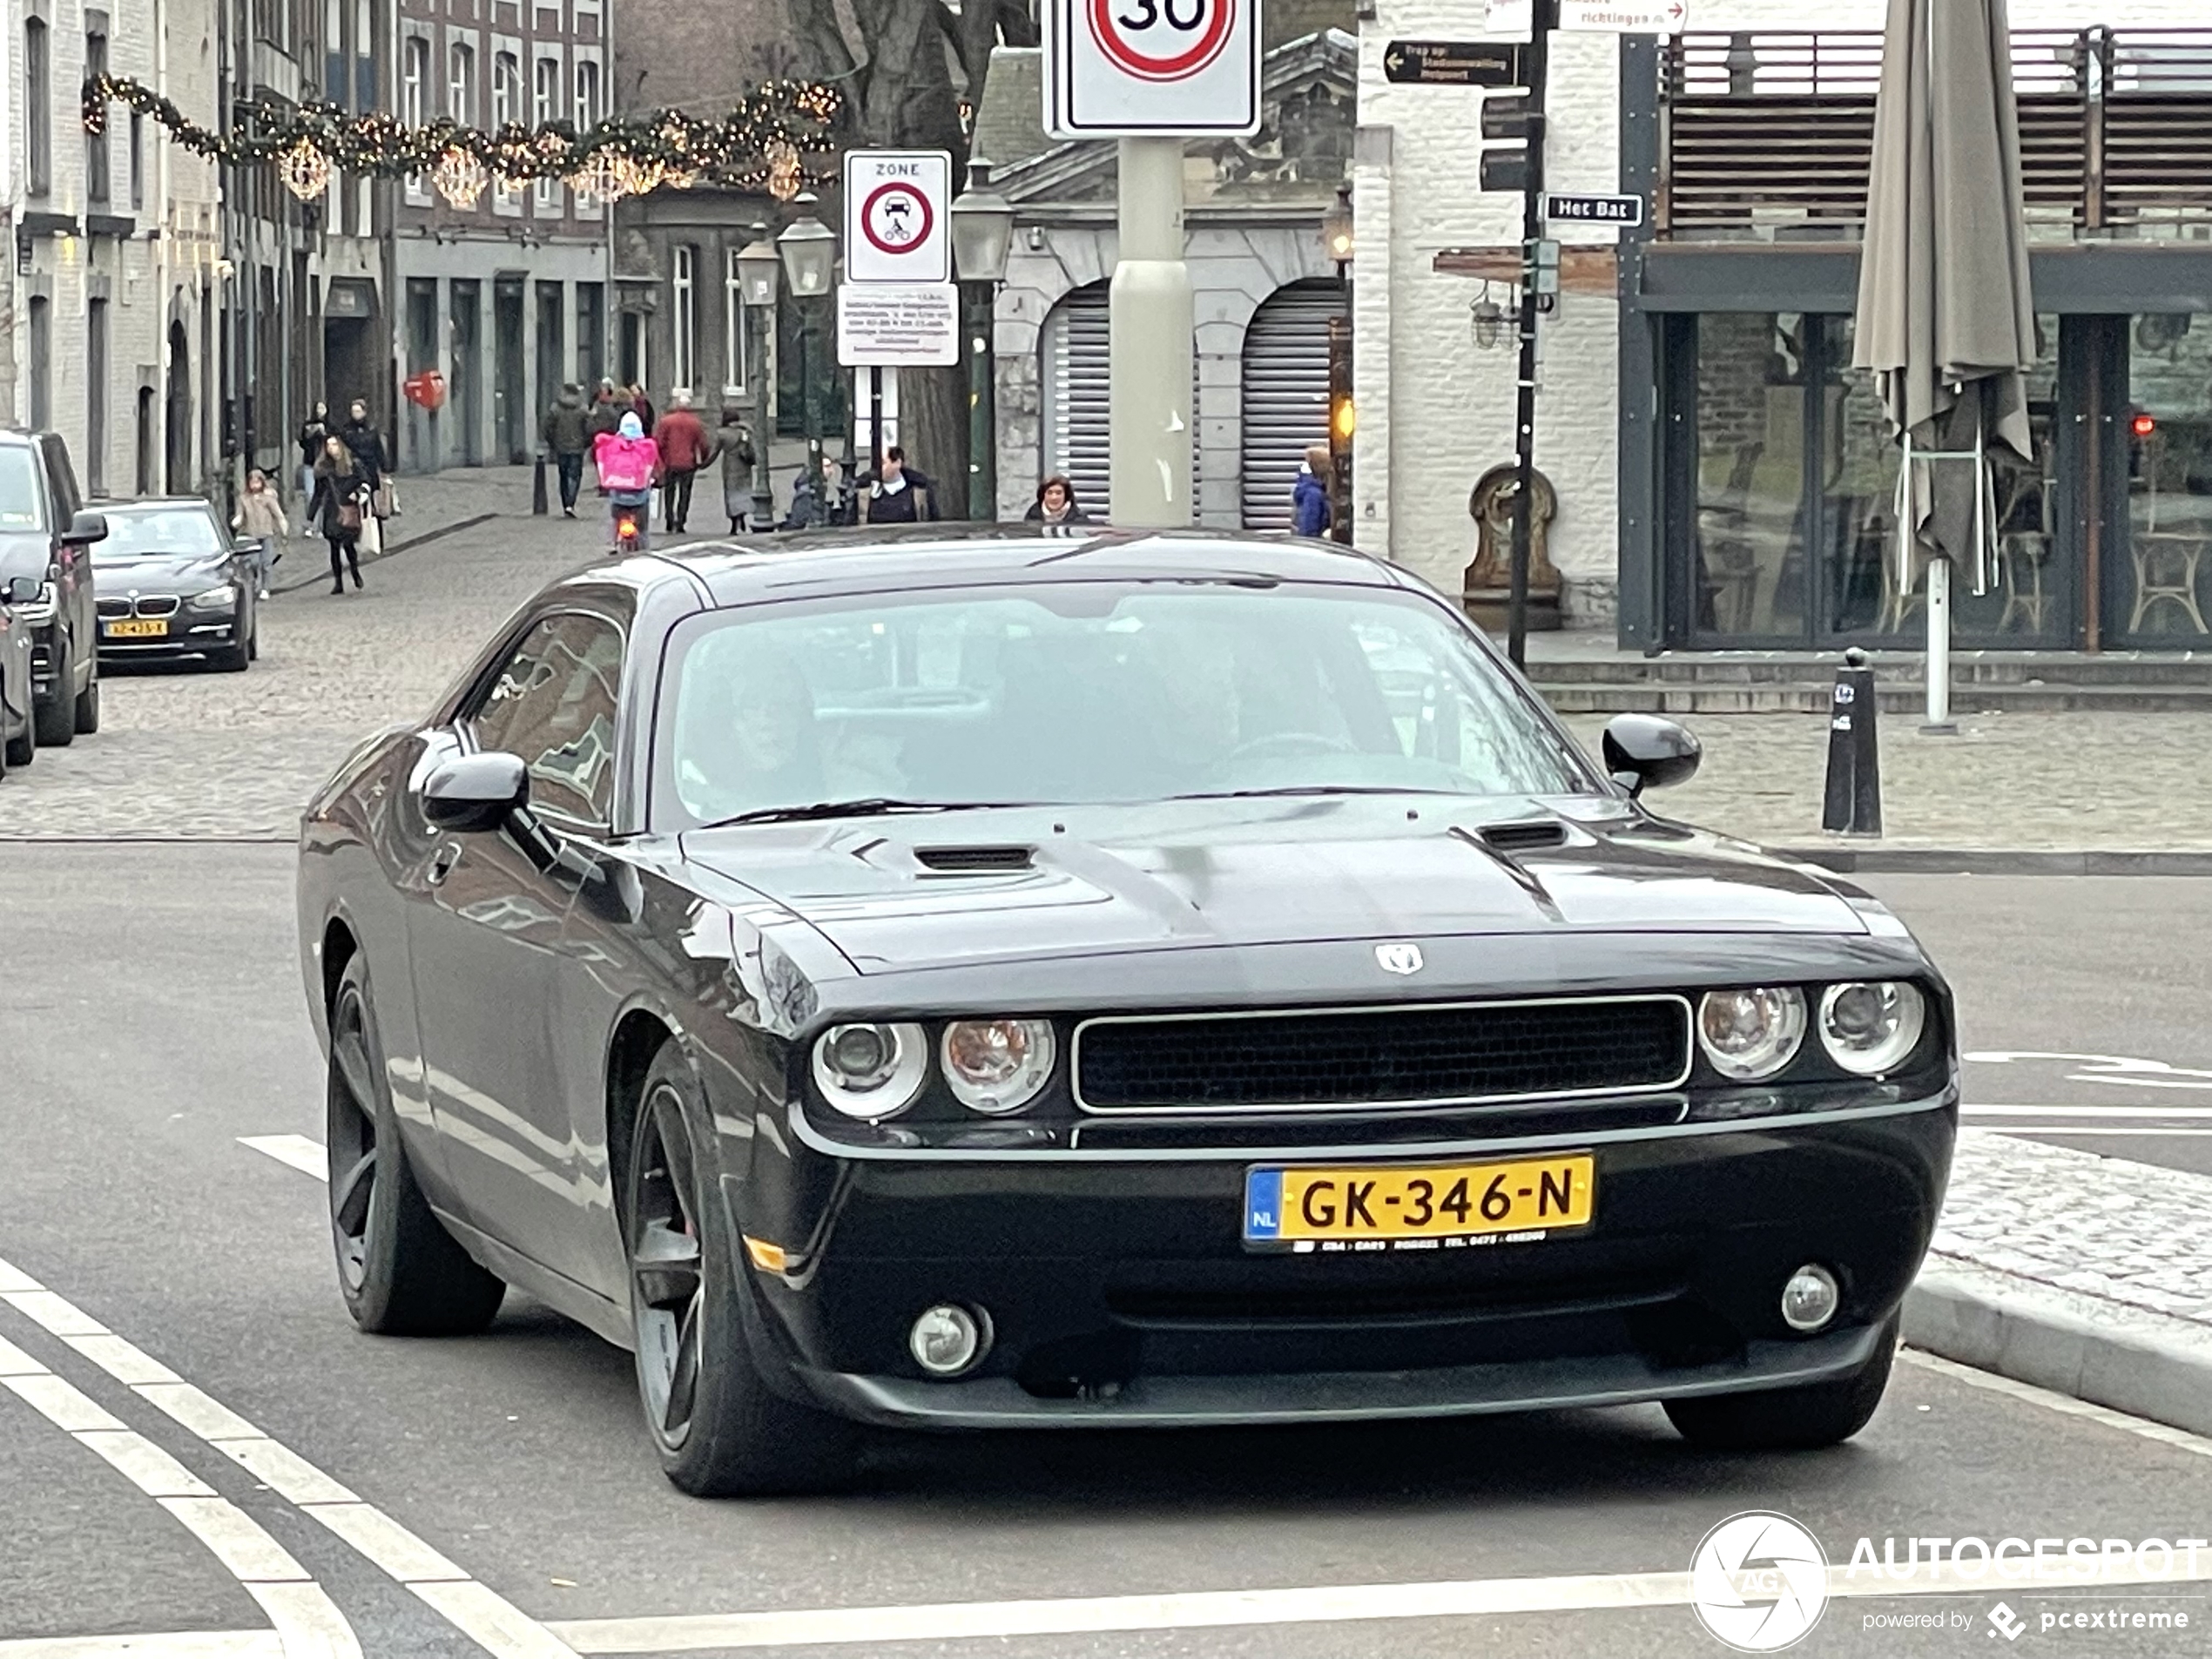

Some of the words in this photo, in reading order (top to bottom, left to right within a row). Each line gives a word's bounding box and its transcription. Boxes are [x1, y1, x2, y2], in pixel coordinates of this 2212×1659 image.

[1118, 0, 1205, 30] 30
[1581, 12, 1649, 26] richtingen
[875, 164, 921, 176] ZONE
[1558, 200, 1590, 216] Het
[1596, 201, 1627, 218] Bat
[1301, 1168, 1572, 1228] GK-346-N
[1252, 1212, 1277, 1228] NL
